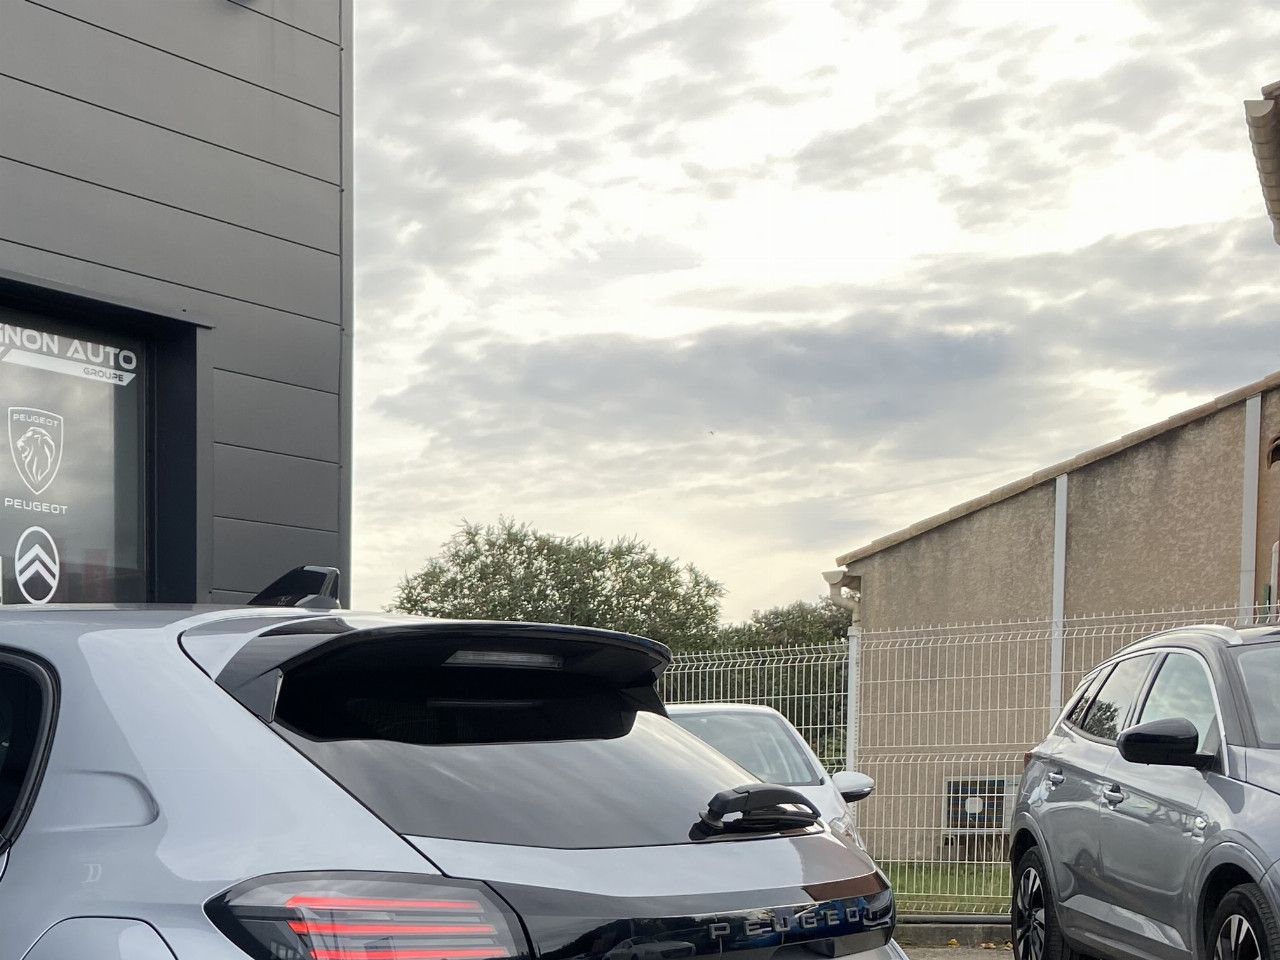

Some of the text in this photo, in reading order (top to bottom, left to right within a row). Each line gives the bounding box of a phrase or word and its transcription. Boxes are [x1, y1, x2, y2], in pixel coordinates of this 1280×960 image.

[67, 338, 137, 370] AUTO
[83, 367, 124, 382] GROUPE
[12, 413, 59, 428] PEUGEOT
[4, 497, 69, 515] PEUGEOT
